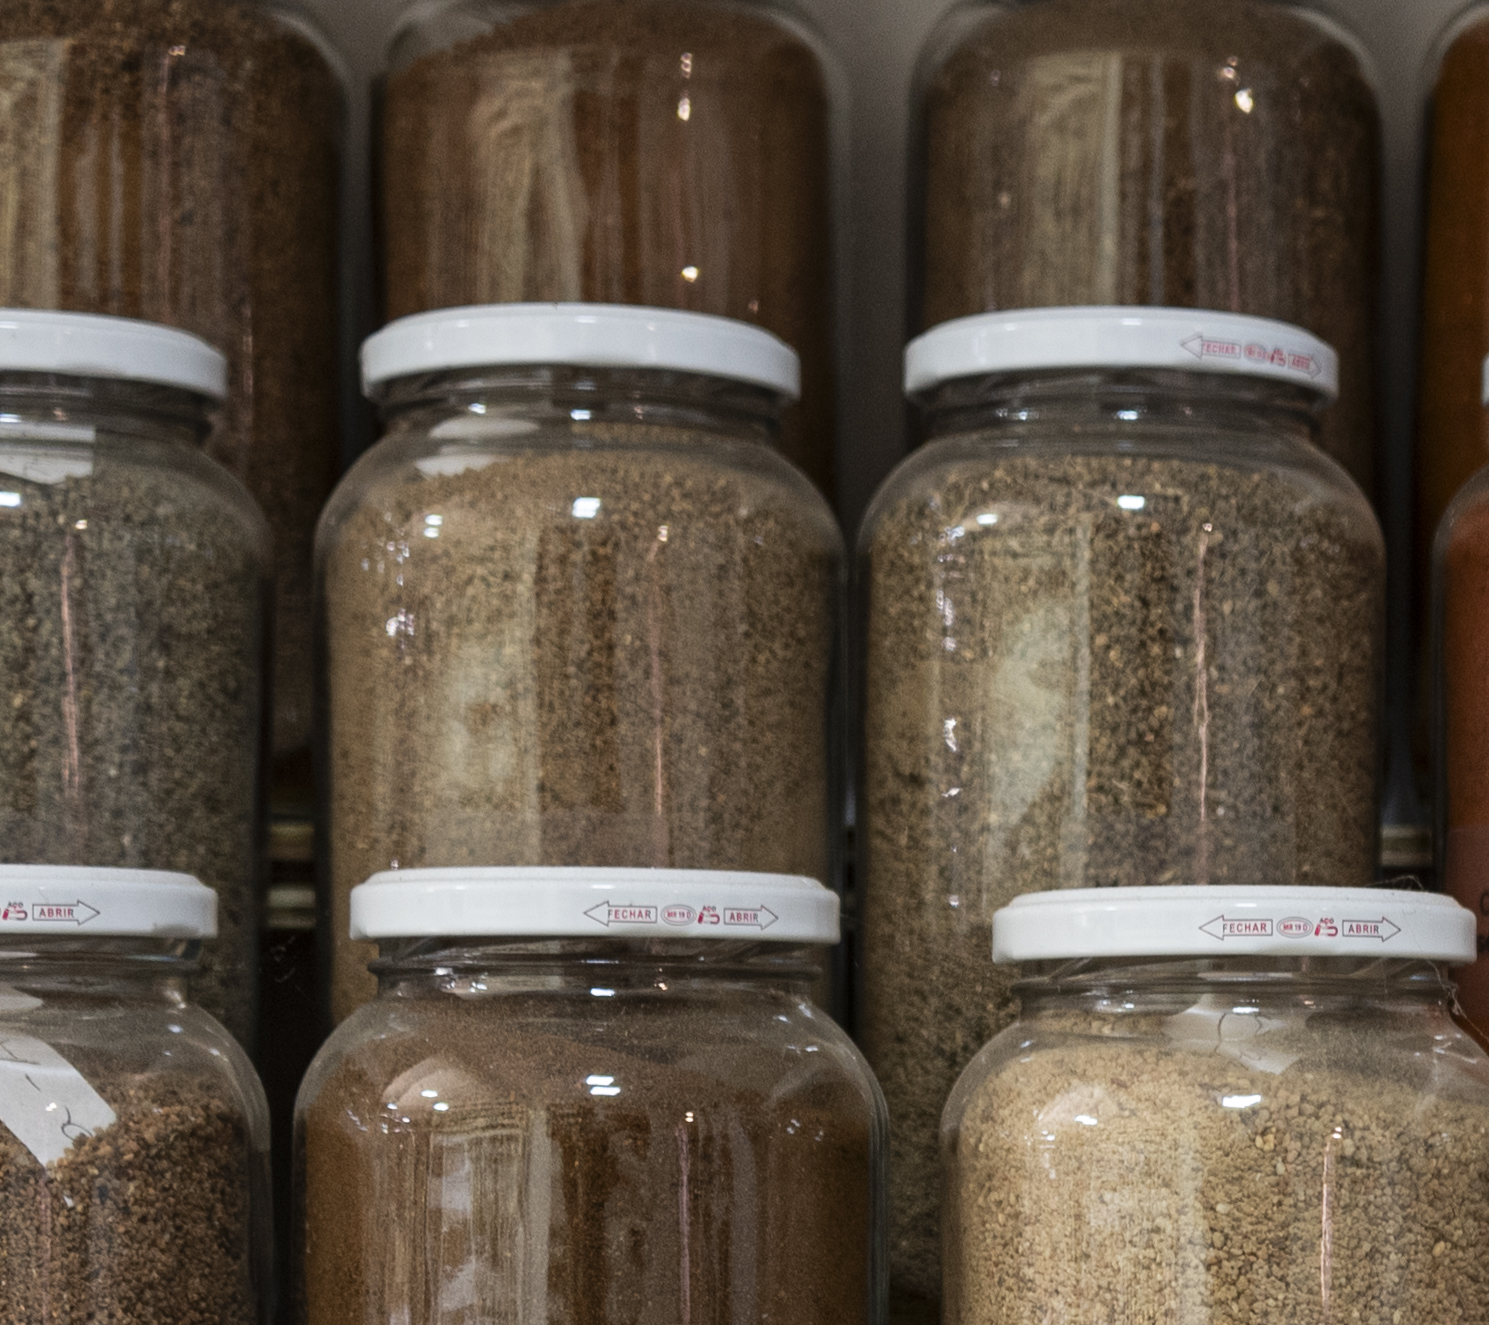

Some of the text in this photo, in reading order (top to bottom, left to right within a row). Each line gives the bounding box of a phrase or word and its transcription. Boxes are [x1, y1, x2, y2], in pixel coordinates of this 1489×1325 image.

[38, 907, 75, 918] ABRIR
[608, 908, 652, 920] FECHAR
[729, 912, 759, 923] ABRIR
[1223, 922, 1267, 934] FECHAR
[1347, 923, 1380, 935] ABRIR
